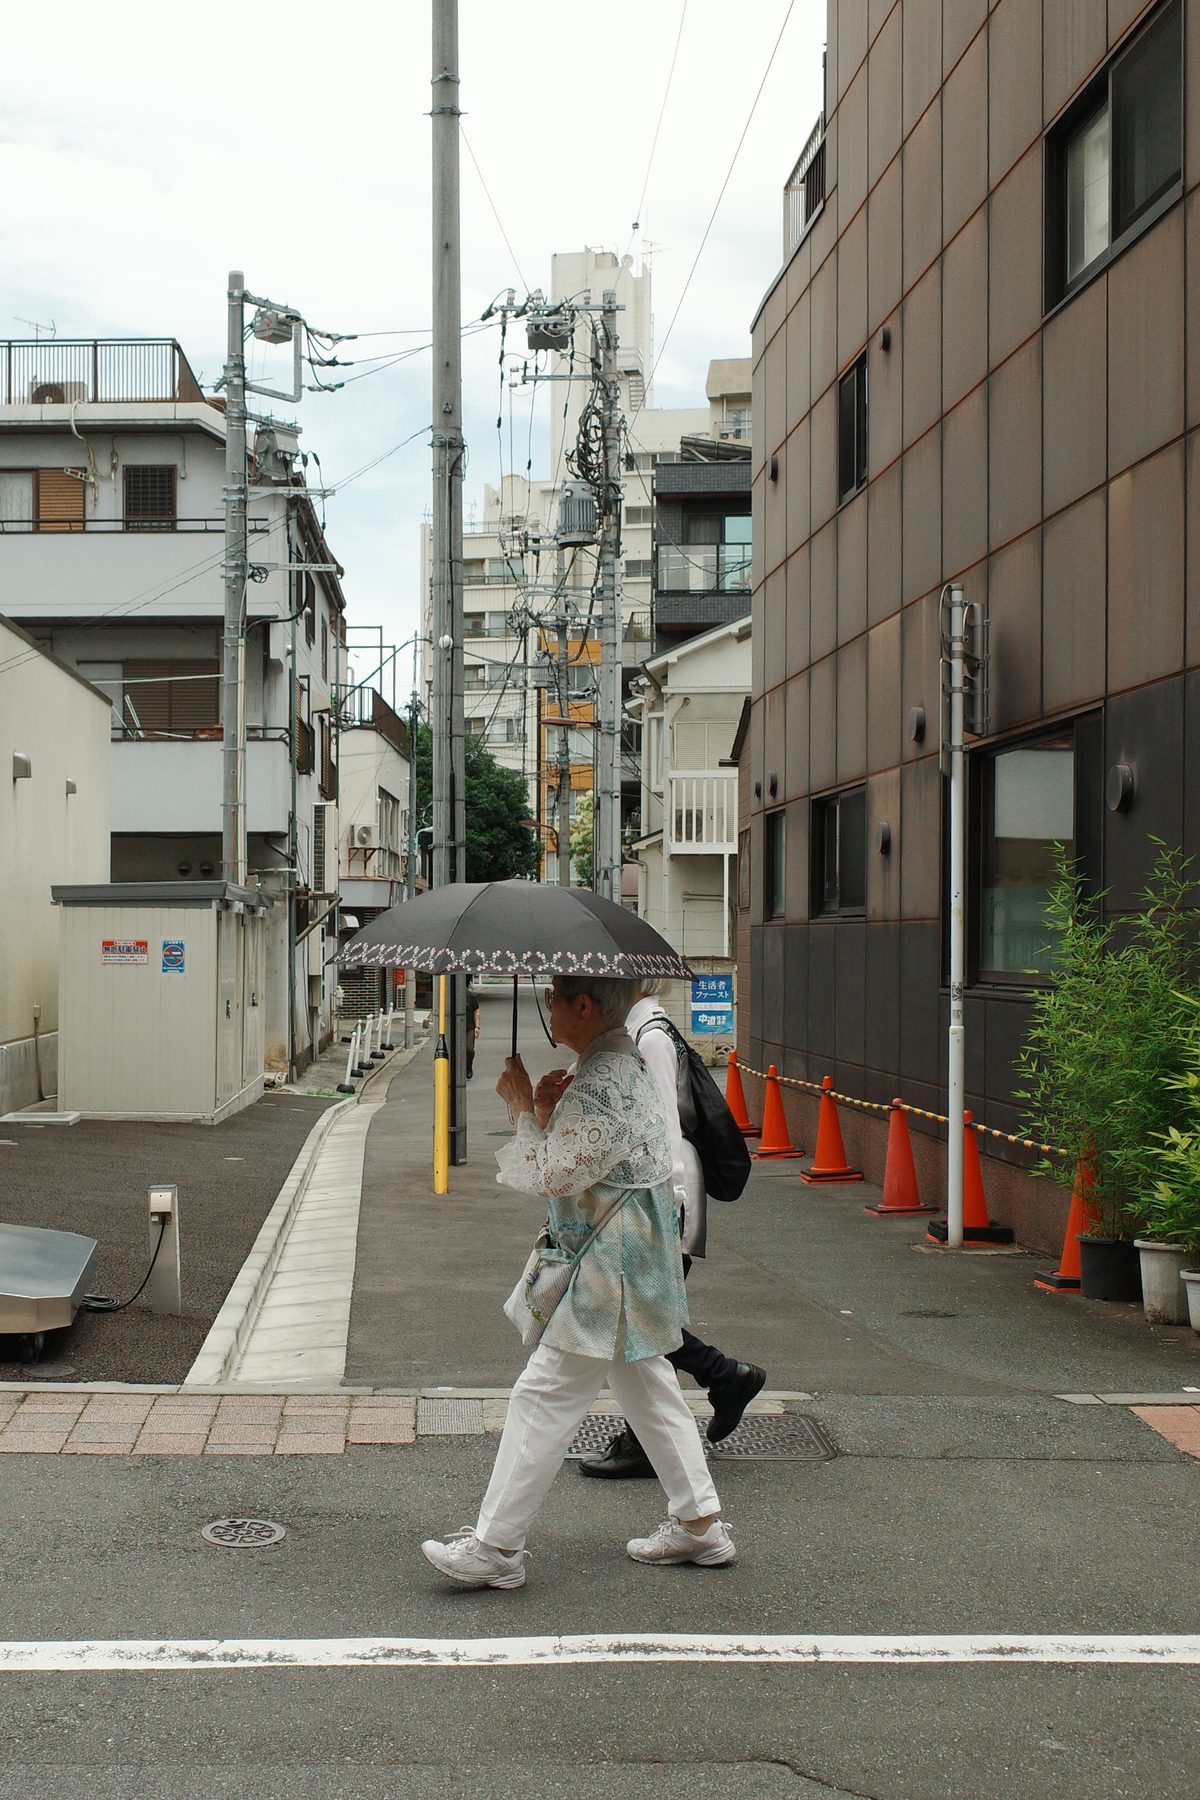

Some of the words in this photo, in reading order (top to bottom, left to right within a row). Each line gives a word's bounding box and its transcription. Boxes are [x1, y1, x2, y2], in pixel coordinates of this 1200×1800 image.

[698, 981, 726, 990] 生活者
[695, 991, 729, 999] ファースト
